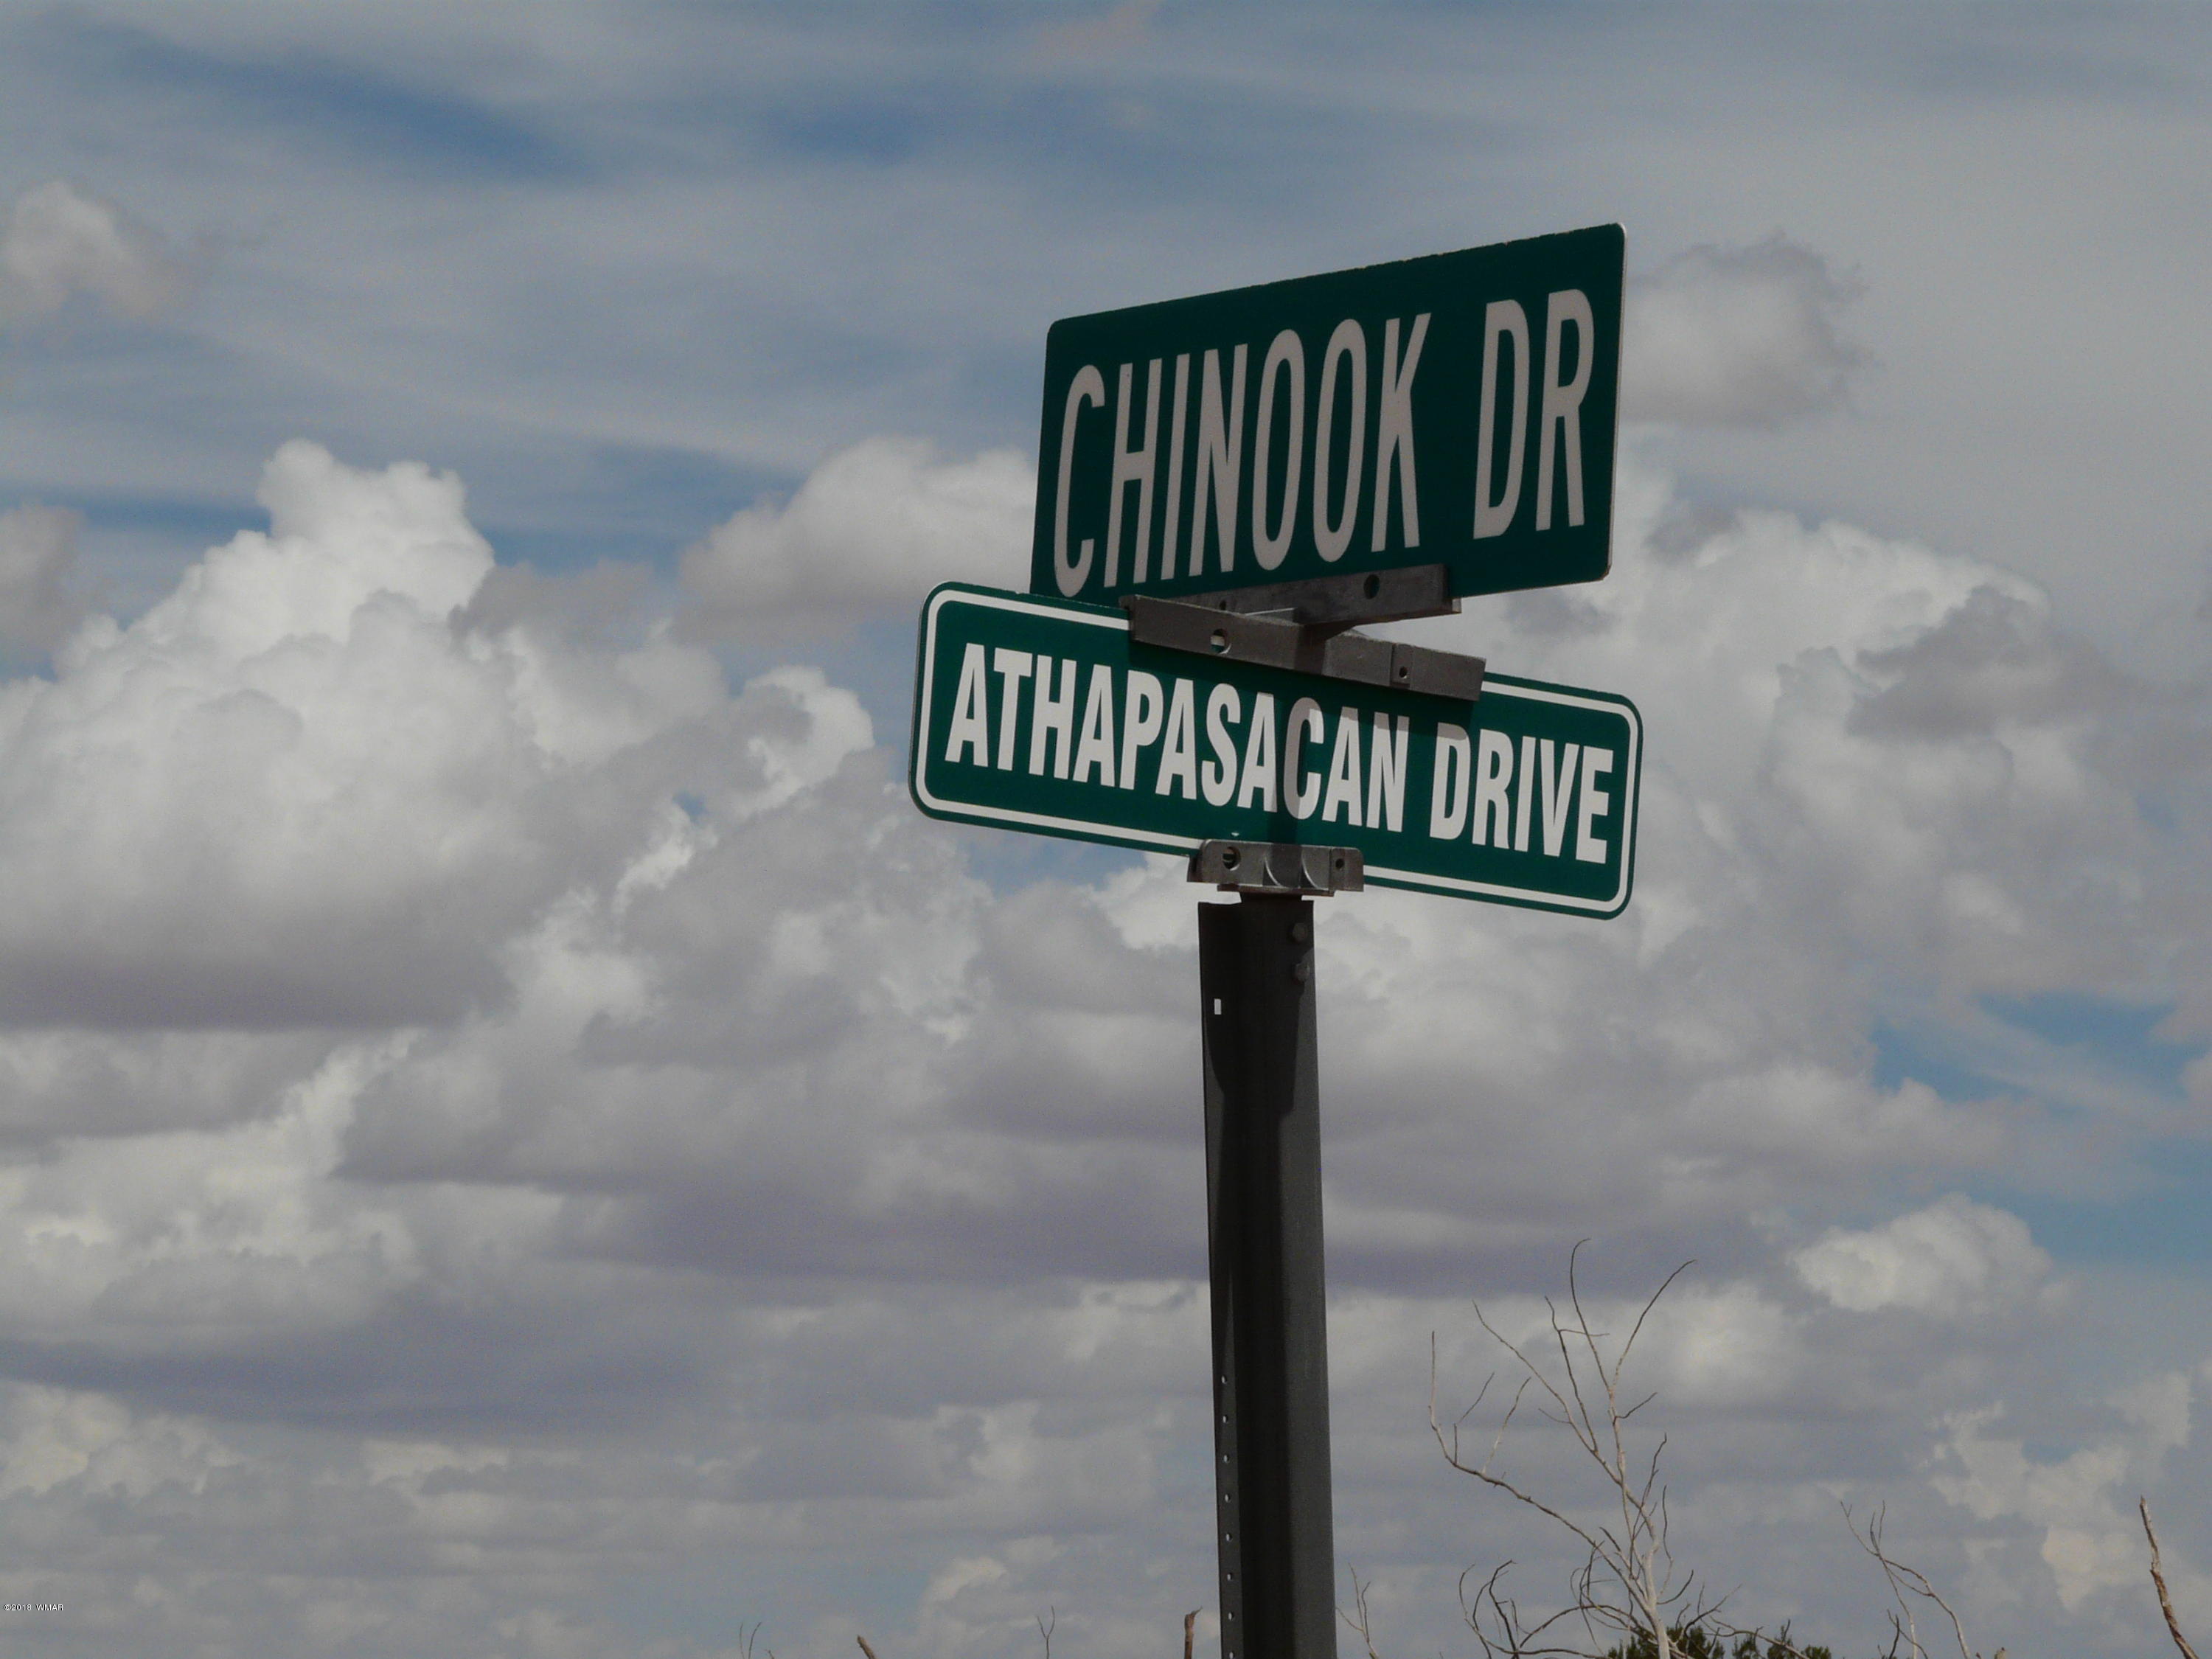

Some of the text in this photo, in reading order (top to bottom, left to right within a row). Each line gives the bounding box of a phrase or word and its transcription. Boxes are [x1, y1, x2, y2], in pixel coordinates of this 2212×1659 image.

[1053, 289, 1594, 597] CHINOOK DR
[945, 643, 1614, 865] ATHAPASACAN DRIVE
